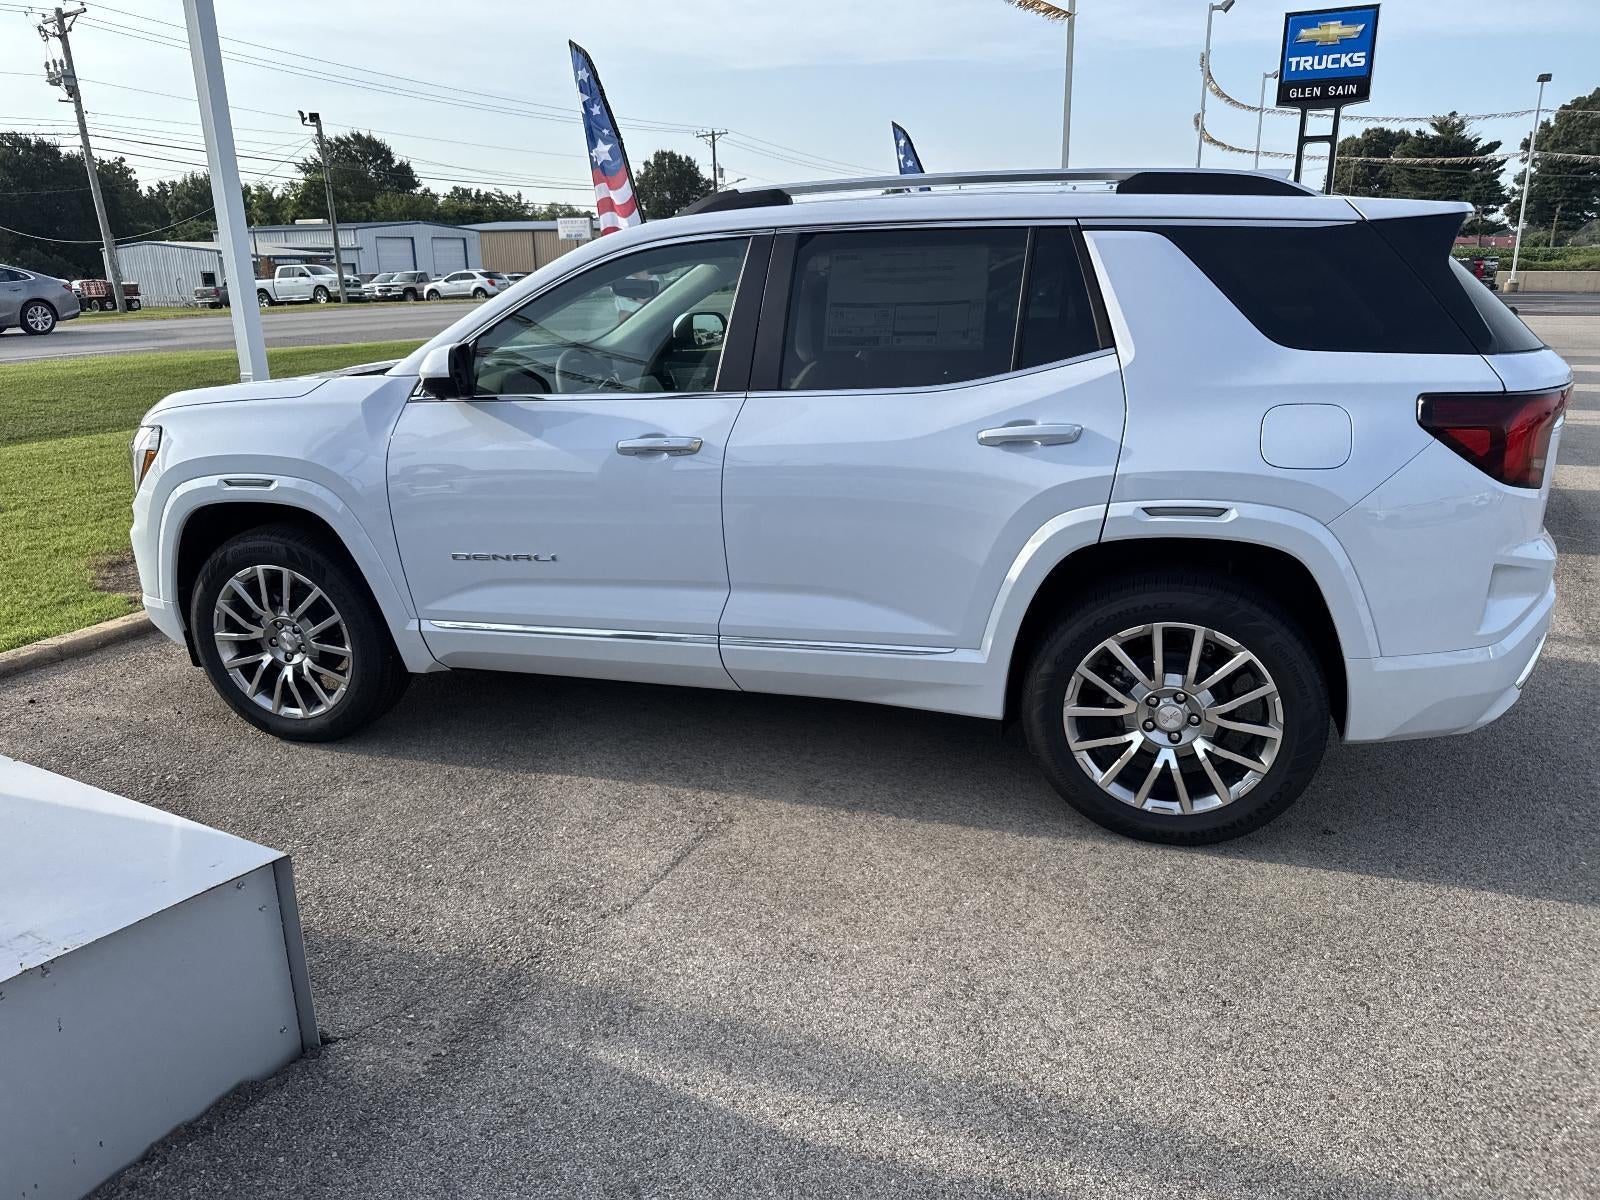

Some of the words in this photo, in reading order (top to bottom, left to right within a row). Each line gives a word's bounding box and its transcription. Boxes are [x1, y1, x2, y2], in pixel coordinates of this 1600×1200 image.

[1288, 52, 1366, 71] TRUCKS
[1289, 87, 1321, 98] GLEN
[1328, 84, 1358, 96] SAIN
[451, 552, 557, 562] DENALI
